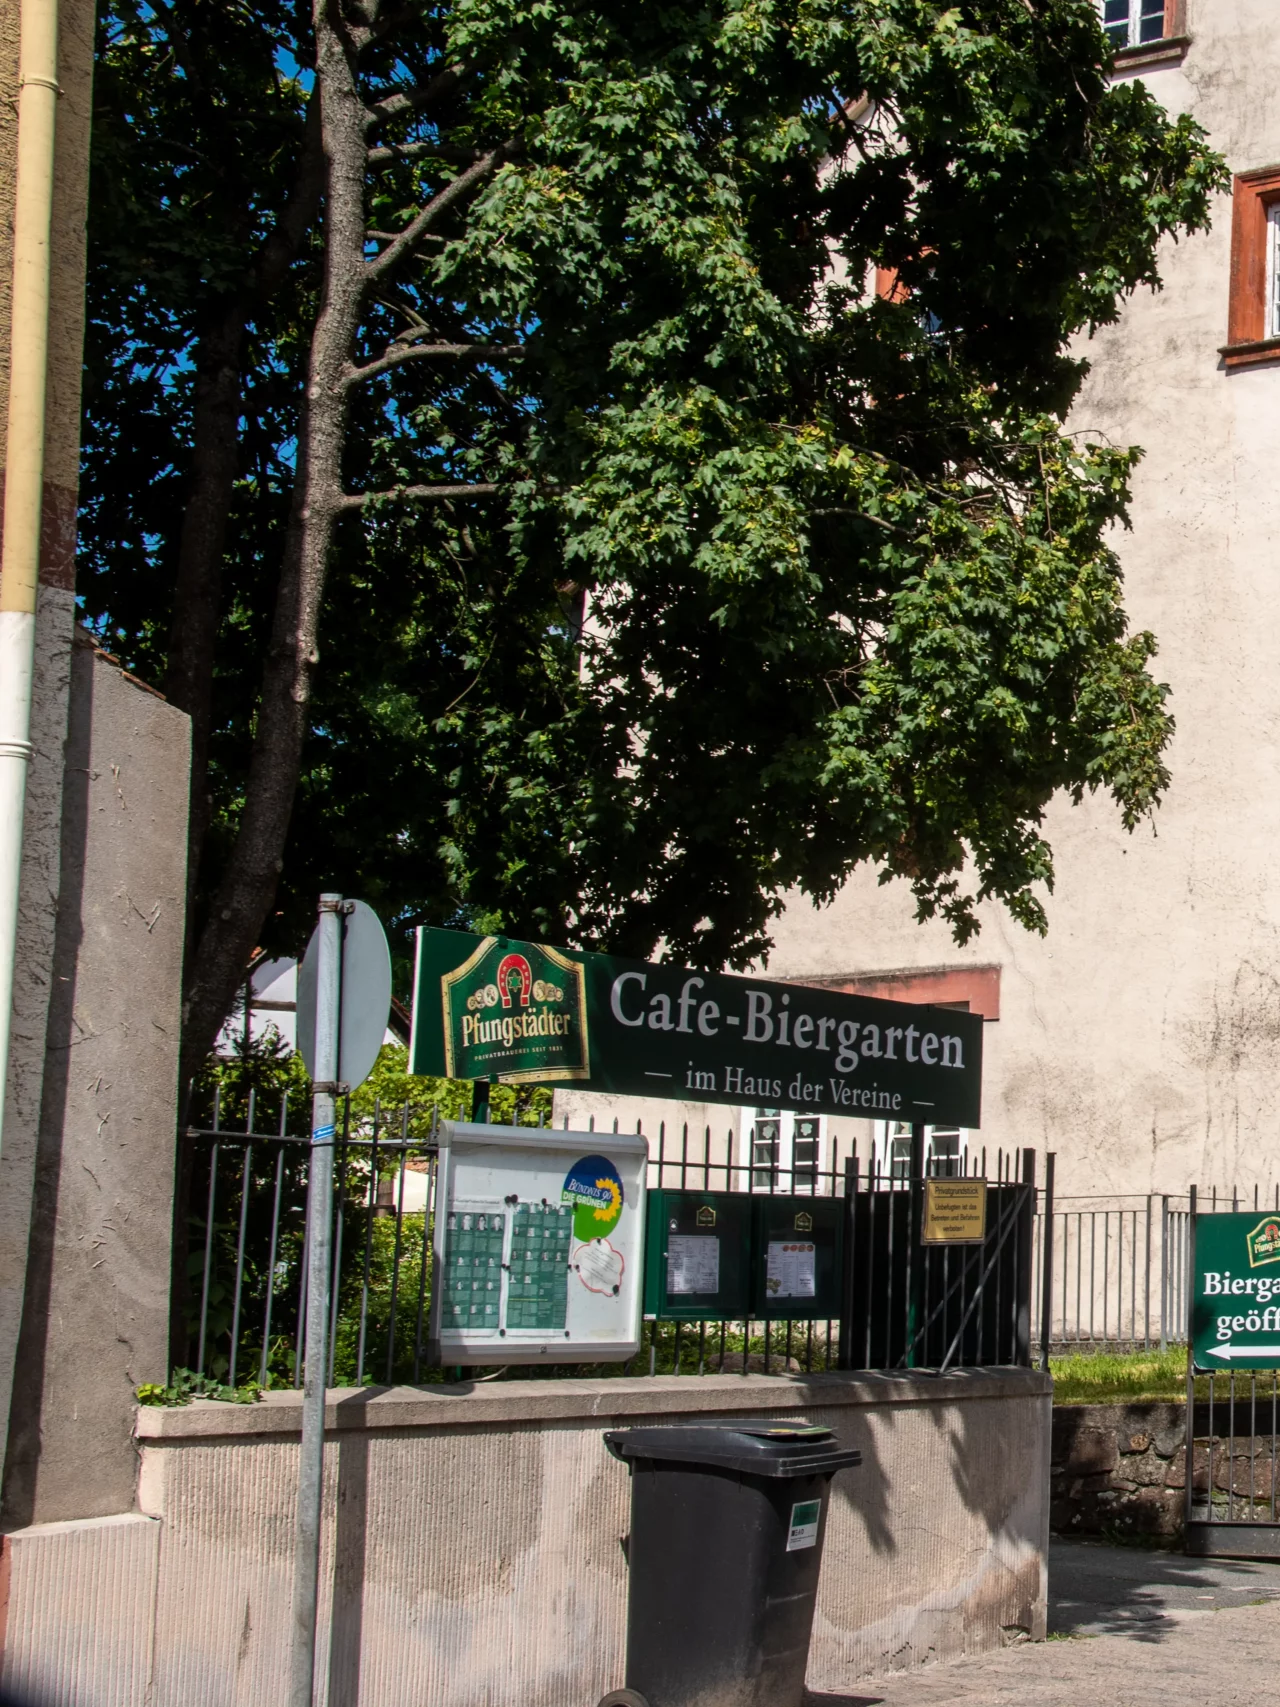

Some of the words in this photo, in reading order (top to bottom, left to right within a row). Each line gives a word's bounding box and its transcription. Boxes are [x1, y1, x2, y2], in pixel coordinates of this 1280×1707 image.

[461, 1005, 571, 1047] Pfungstädter
[610, 971, 965, 1073] Cafe-Biergarten
[474, 1047, 529, 1061] PRIVATBRAUEREI
[685, 1061, 717, 1091] im
[723, 1066, 782, 1098] Haus
[788, 1072, 824, 1102] der
[829, 1078, 902, 1111] Vereine
[563, 1191, 575, 1202] DIE
[576, 1193, 607, 1210] GRÜNEN
[568, 1178, 601, 1198] BÜNDNIS
[602, 1190, 612, 1200] 90
